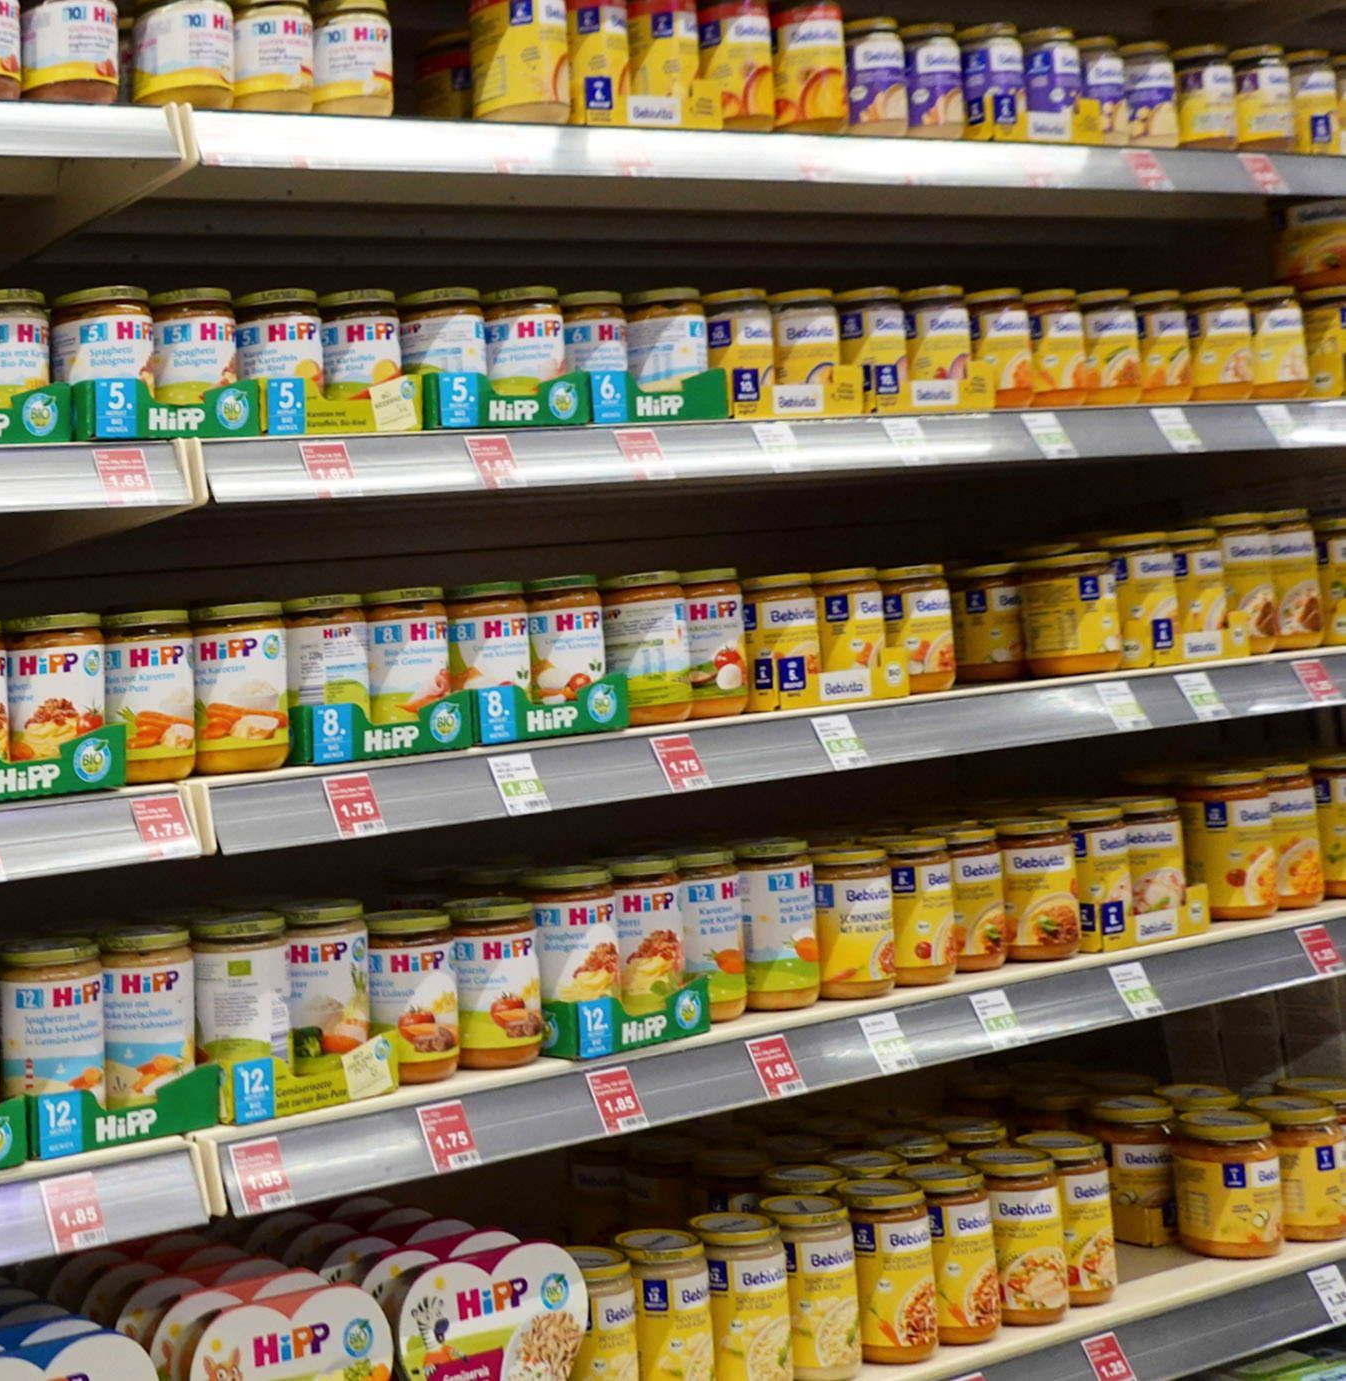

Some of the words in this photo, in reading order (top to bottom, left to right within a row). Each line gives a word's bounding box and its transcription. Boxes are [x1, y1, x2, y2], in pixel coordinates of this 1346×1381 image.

[267, 322, 318, 344] HiPP
[346, 322, 396, 343] HiPP
[517, 320, 561, 340] HiPP
[108, 382, 133, 410] 5.
[278, 382, 303, 409] 5.
[451, 376, 476, 403] 5.
[599, 374, 622, 400] 6.
[31, 407, 51, 422] BIO
[488, 399, 540, 423] HiPP
[635, 394, 685, 418] HiPP
[148, 407, 206, 432] HiPP
[108, 474, 145, 489] 1.65
[555, 611, 600, 632] HiPP
[689, 601, 738, 621] HiPP
[129, 644, 184, 668] HiPP
[199, 637, 258, 661] HiPP
[18, 651, 79, 676] HiPP
[824, 682, 864, 696] Bebivita
[486, 690, 511, 718] 8.
[321, 709, 347, 736] 8.
[436, 714, 455, 729] BIO
[526, 706, 579, 732] HiPP
[364, 725, 420, 752] HiPP
[81, 752, 103, 768] BIO
[668, 759, 700, 774] 1.75
[339, 800, 375, 817] 1.75
[147, 822, 184, 839] 1.75
[568, 903, 614, 926] HiPP
[622, 891, 675, 914] HiPP
[290, 941, 348, 965] HiPP
[482, 937, 533, 961] HiPP
[390, 950, 445, 974] HiPP
[52, 980, 101, 1009] HiPP
[121, 970, 180, 995] HiPP
[621, 1015, 667, 1045] HiPP
[240, 1067, 270, 1096] 12.
[764, 1063, 795, 1080] 1.85
[45, 1099, 78, 1129] 12.
[604, 1096, 636, 1113] 1.85
[95, 1107, 158, 1142] HiPP
[434, 1131, 469, 1149] 1.75
[59, 1207, 99, 1228] 1.85
[999, 1201, 1052, 1217] Bebivita
[456, 1276, 528, 1321] HiPP
[544, 1285, 565, 1302] BIO
[252, 1322, 330, 1368] HiPP
